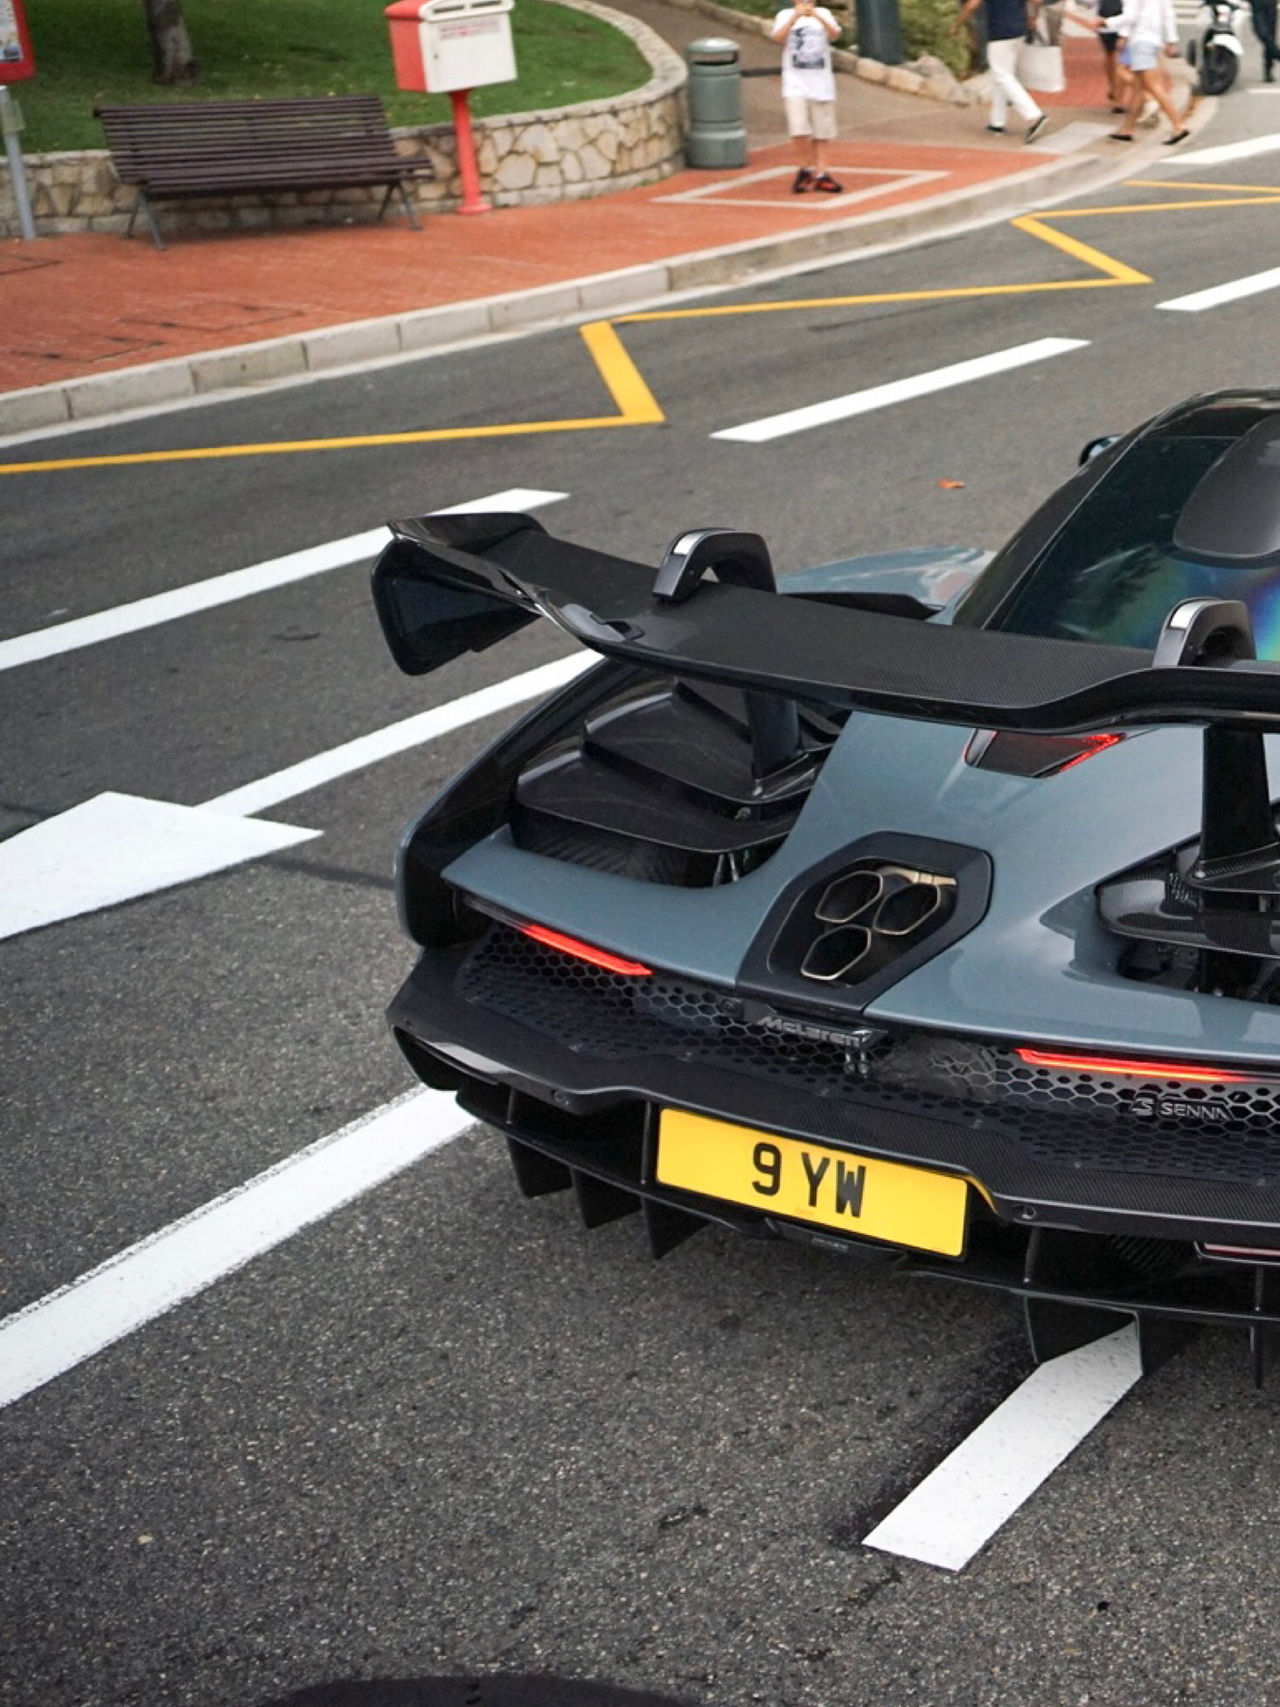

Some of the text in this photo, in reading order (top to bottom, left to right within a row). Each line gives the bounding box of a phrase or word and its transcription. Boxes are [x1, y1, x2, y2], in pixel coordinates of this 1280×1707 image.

[757, 1016, 860, 1047] McLaren
[752, 1141, 866, 1219] 9 YW
